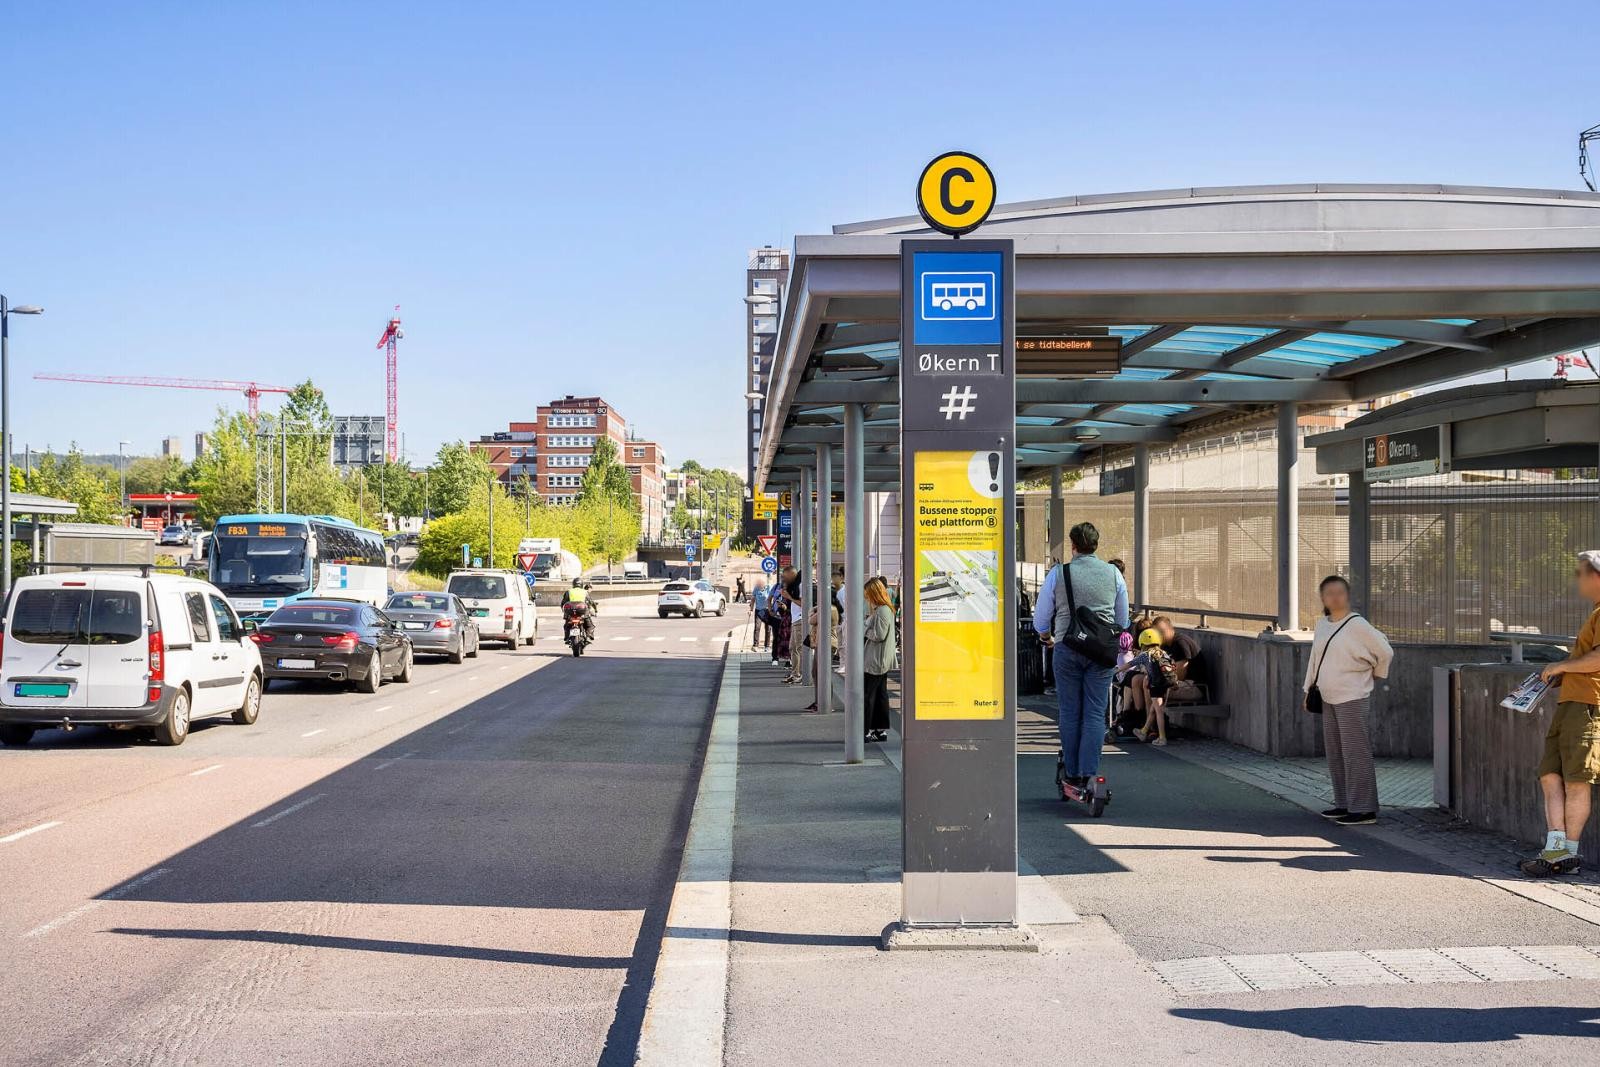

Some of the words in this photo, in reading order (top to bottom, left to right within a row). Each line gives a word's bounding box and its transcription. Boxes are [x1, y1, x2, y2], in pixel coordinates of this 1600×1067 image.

[940, 167, 975, 215] C
[919, 353, 979, 372] Økern
[987, 353, 999, 371] T
[1389, 441, 1411, 458] Økern
[920, 506, 958, 514] Bussene
[960, 507, 997, 516] stopper
[920, 517, 937, 526] ved
[940, 517, 984, 527] plattform
[228, 526, 248, 535] FB3A
